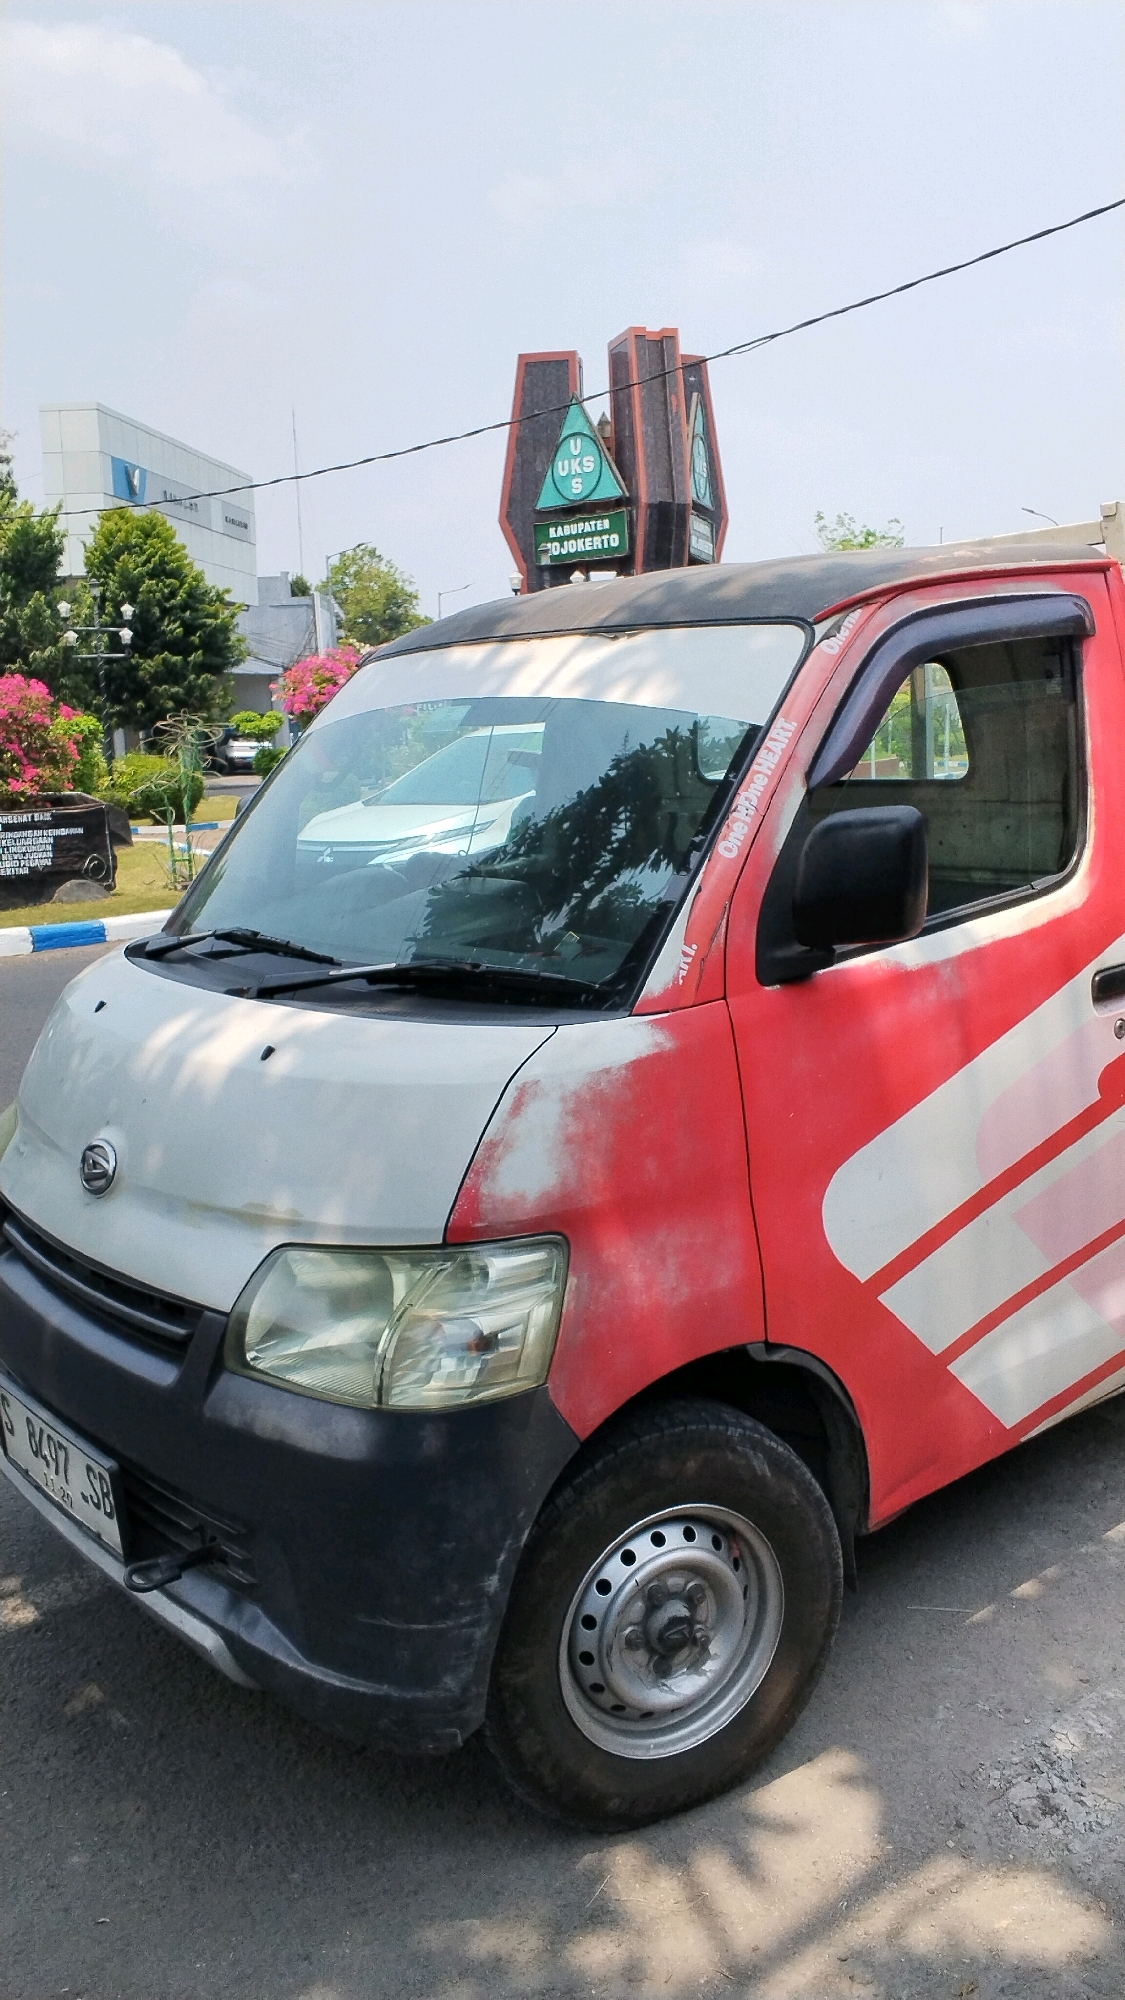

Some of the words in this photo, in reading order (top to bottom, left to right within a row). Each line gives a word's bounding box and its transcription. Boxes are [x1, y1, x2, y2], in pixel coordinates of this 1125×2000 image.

[570, 437, 582, 455] U
[557, 455, 595, 476] UKS
[571, 476, 584, 494] S
[549, 518, 610, 538] KABUPATEN
[0, 1393, 15, 1436] S
[25, 1416, 70, 1486] 8497
[85, 1463, 115, 1520] SB
